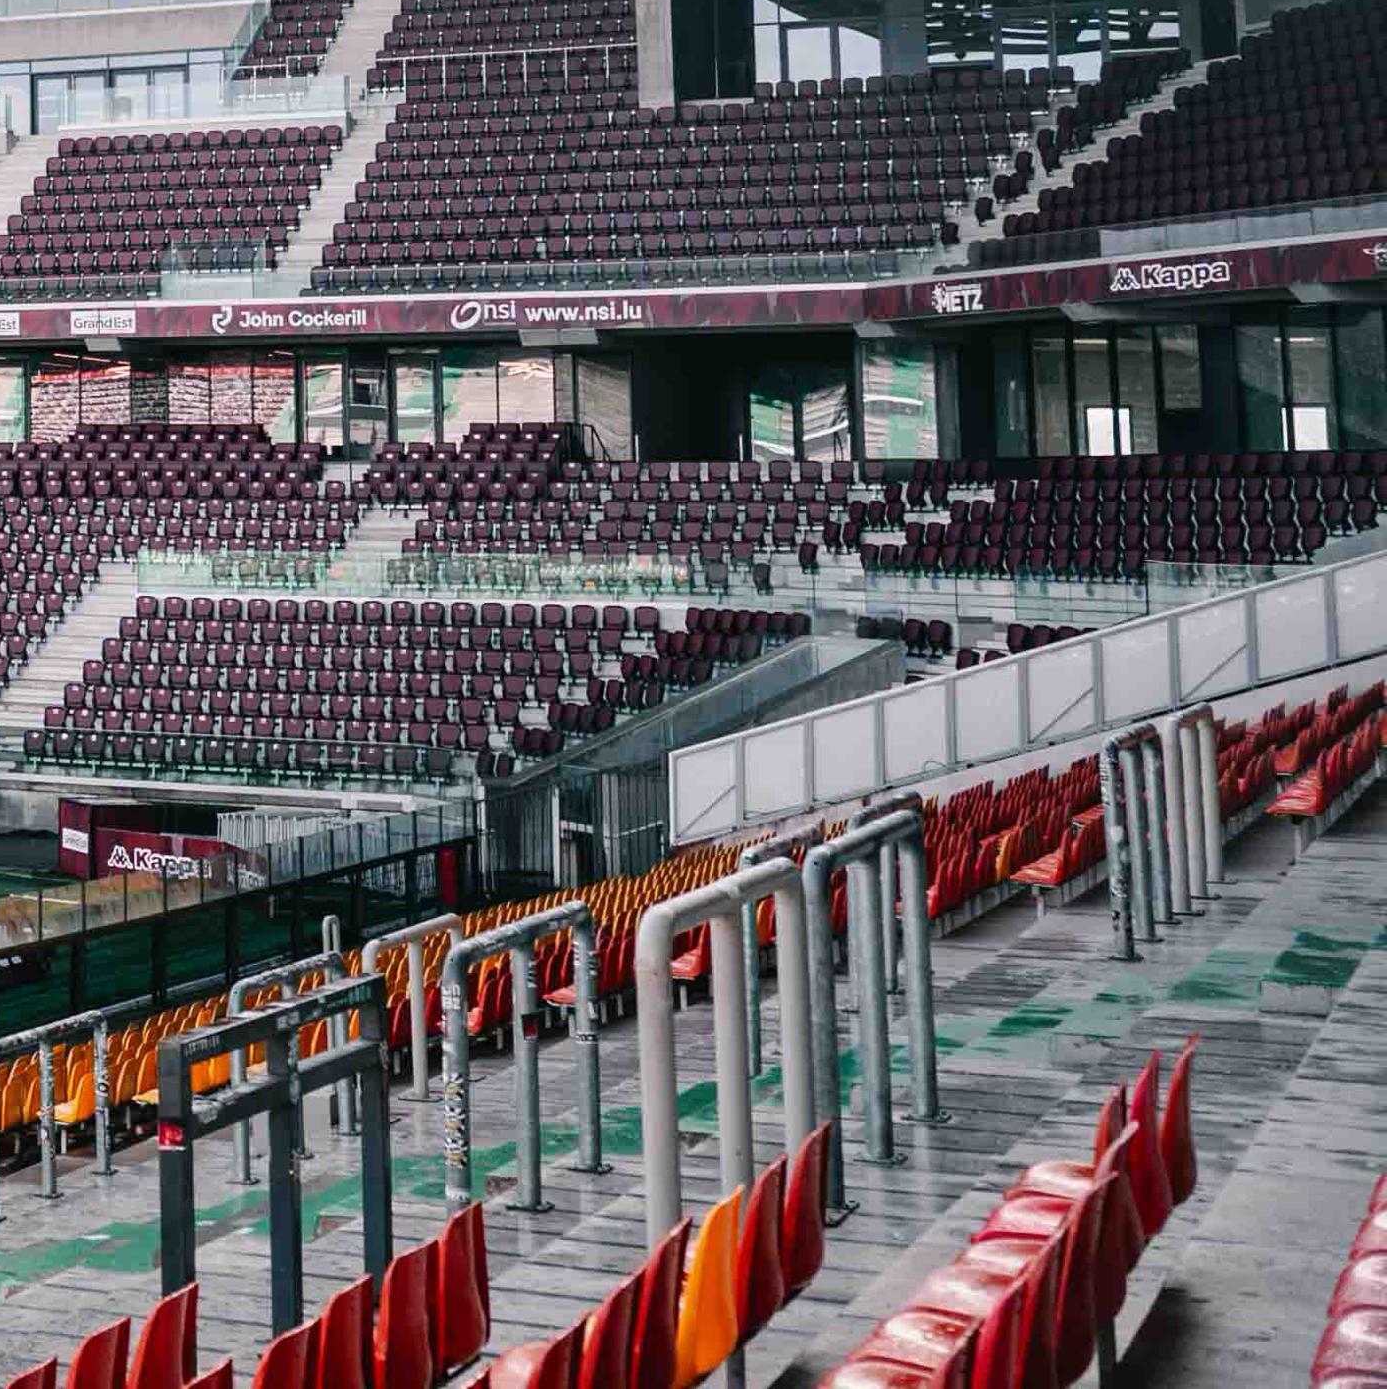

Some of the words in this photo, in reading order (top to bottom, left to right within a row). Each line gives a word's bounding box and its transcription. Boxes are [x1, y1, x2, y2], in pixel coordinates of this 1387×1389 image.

[1141, 262, 1231, 290] Kappa
[484, 300, 516, 320] nsi
[525, 300, 642, 322] www.nsi.lu
[937, 289, 984, 313] METZ
[239, 311, 284, 328] John
[288, 309, 367, 326] Cockerill
[133, 848, 213, 880] Kappa
